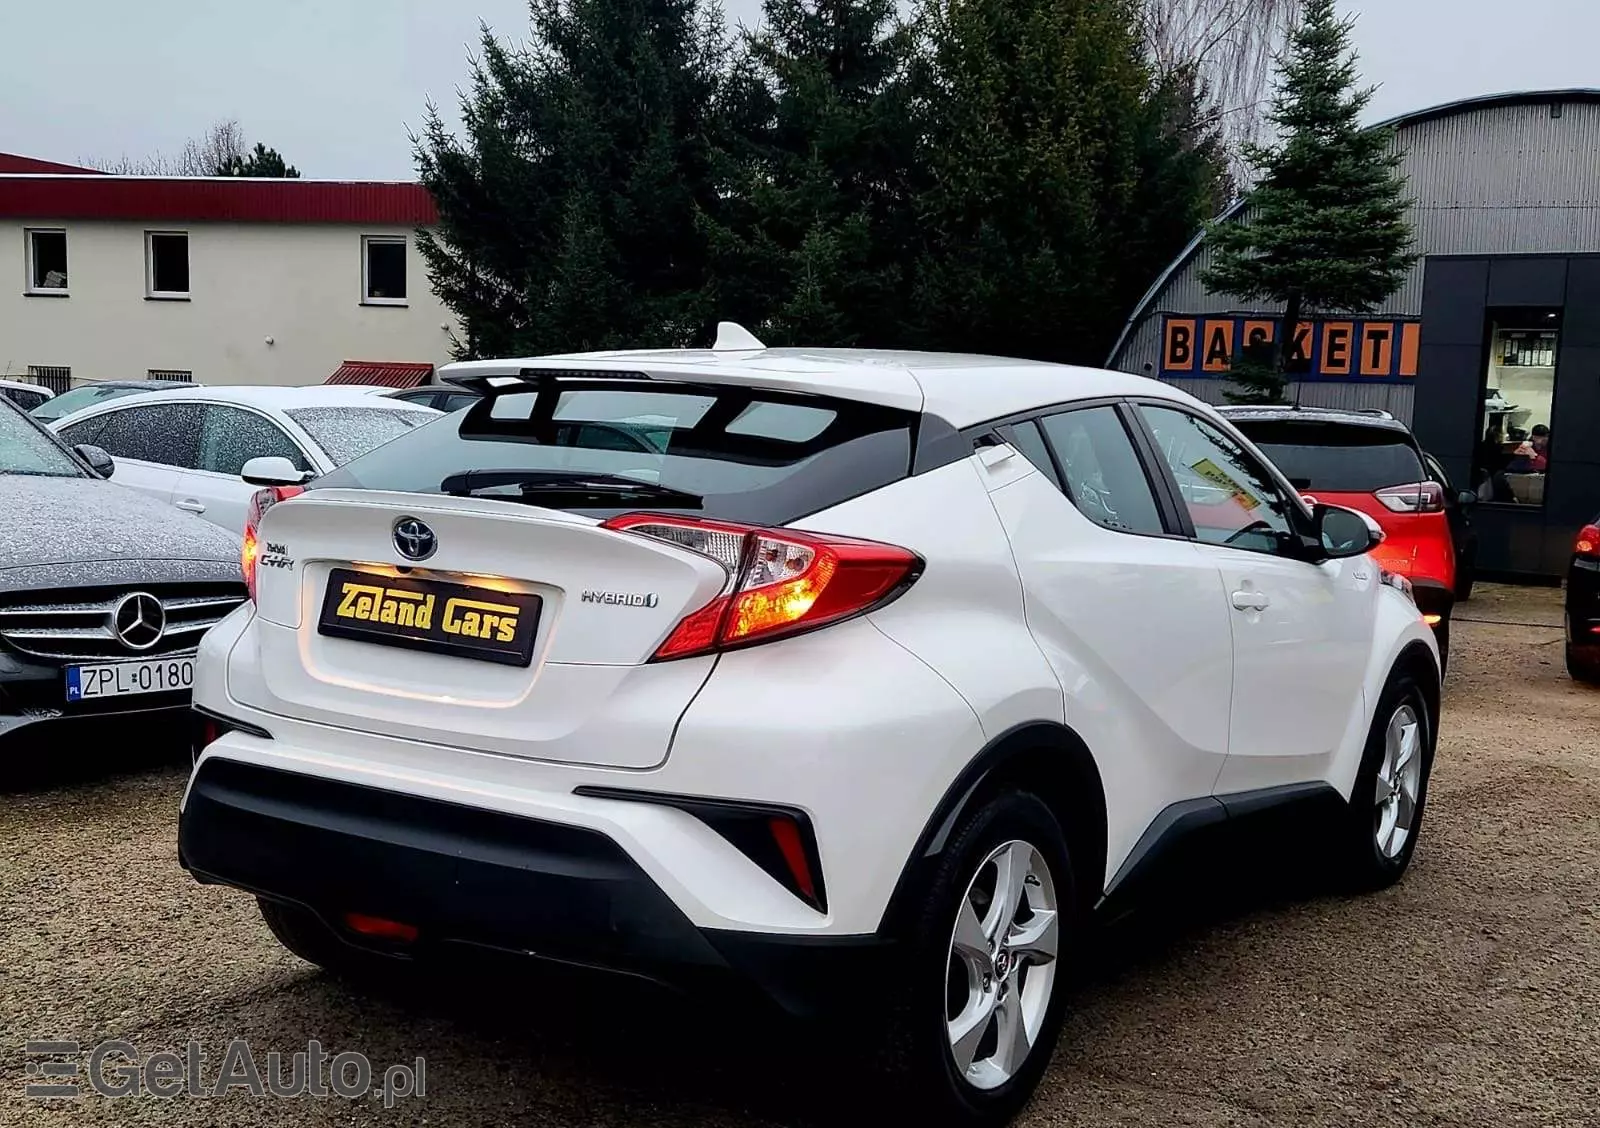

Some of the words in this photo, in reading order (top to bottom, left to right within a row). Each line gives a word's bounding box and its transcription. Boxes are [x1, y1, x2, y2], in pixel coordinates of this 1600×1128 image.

[581, 589, 646, 607] HYBRID
[336, 582, 436, 630] Zeland
[442, 597, 521, 642] Cars
[69, 686, 80, 695] PL
[81, 667, 130, 696] ZPL
